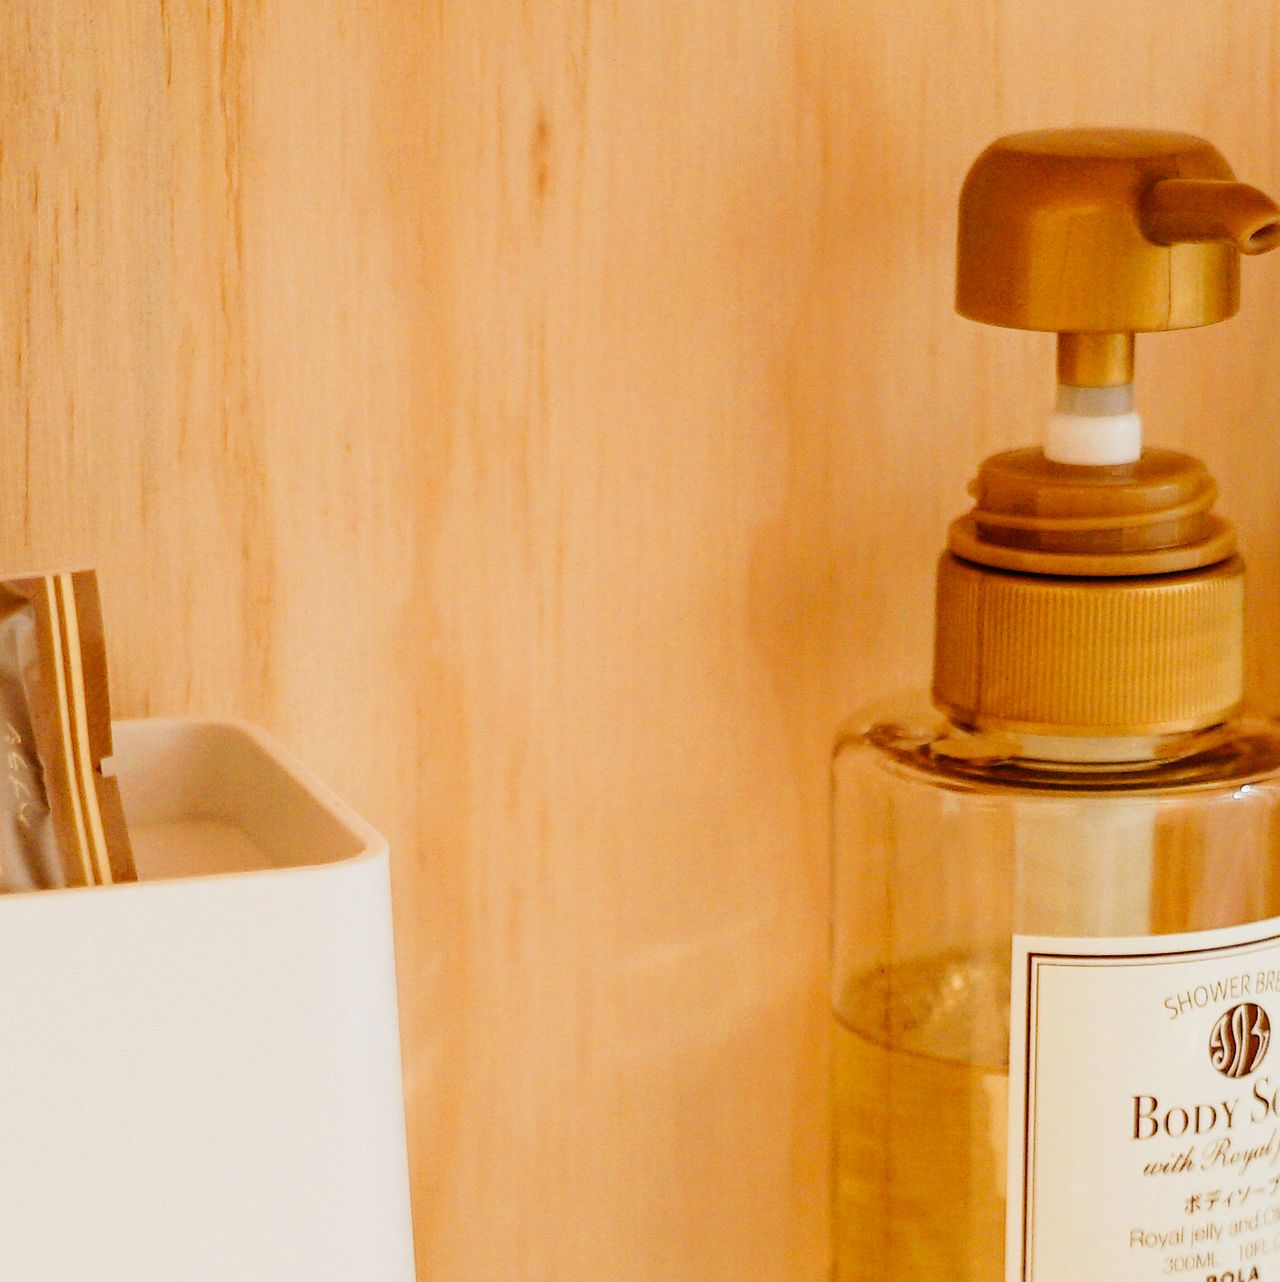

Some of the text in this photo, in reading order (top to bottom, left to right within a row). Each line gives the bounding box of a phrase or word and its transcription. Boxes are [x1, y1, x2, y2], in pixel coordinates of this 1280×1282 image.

[1163, 974, 1251, 1020] SHOWER
[1131, 1095, 1241, 1140] BODY
[1143, 1145, 1195, 1177] with
[1200, 1127, 1277, 1177] Royal
[1129, 1225, 1184, 1249] Royal
[1190, 1222, 1223, 1248] jelly
[1229, 1209, 1260, 1238] and
[1163, 1252, 1218, 1274] 300ML
